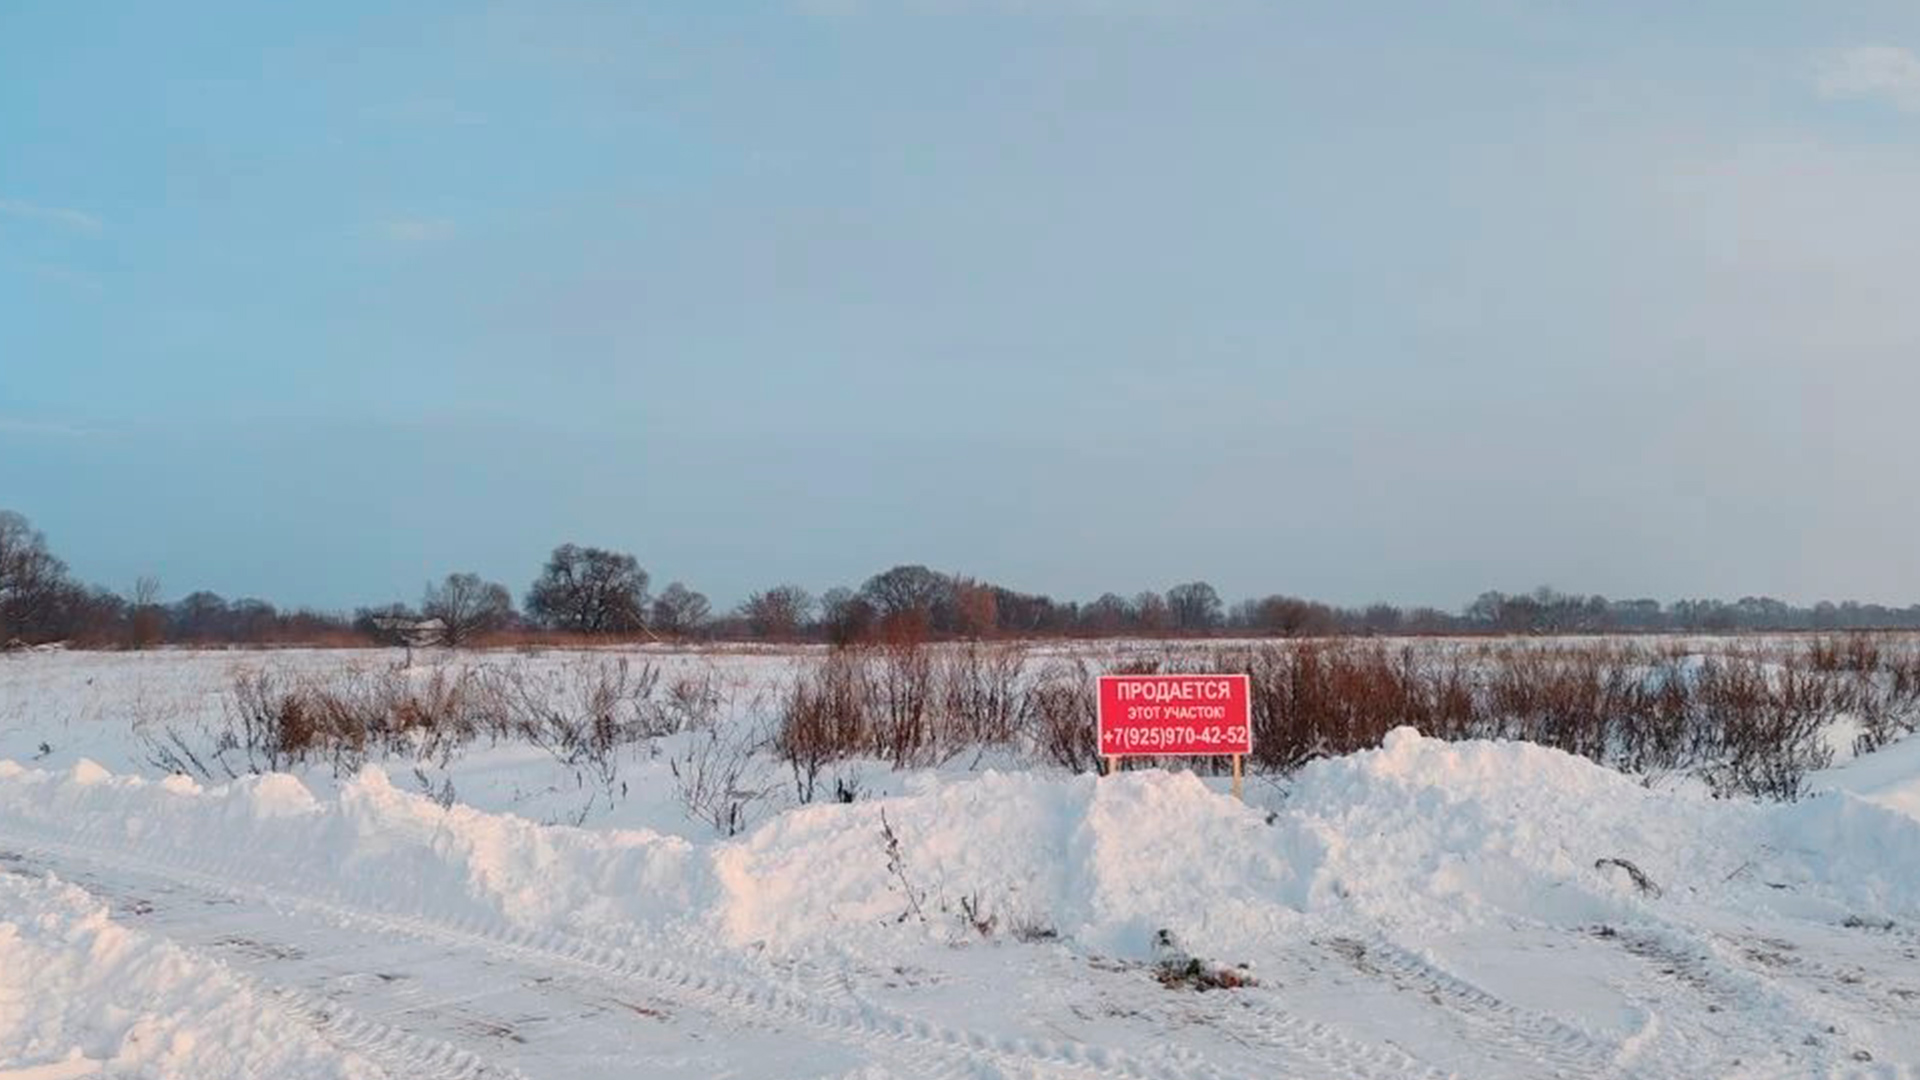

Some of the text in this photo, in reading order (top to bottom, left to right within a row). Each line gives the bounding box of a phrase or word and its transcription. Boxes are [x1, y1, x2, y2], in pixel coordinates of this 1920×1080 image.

[1117, 681, 1231, 702] ПРОДАЕТСЯ
[1127, 706, 1161, 719] ЭТОТ
[1103, 726, 1247, 749] +7(925)970-42-52
